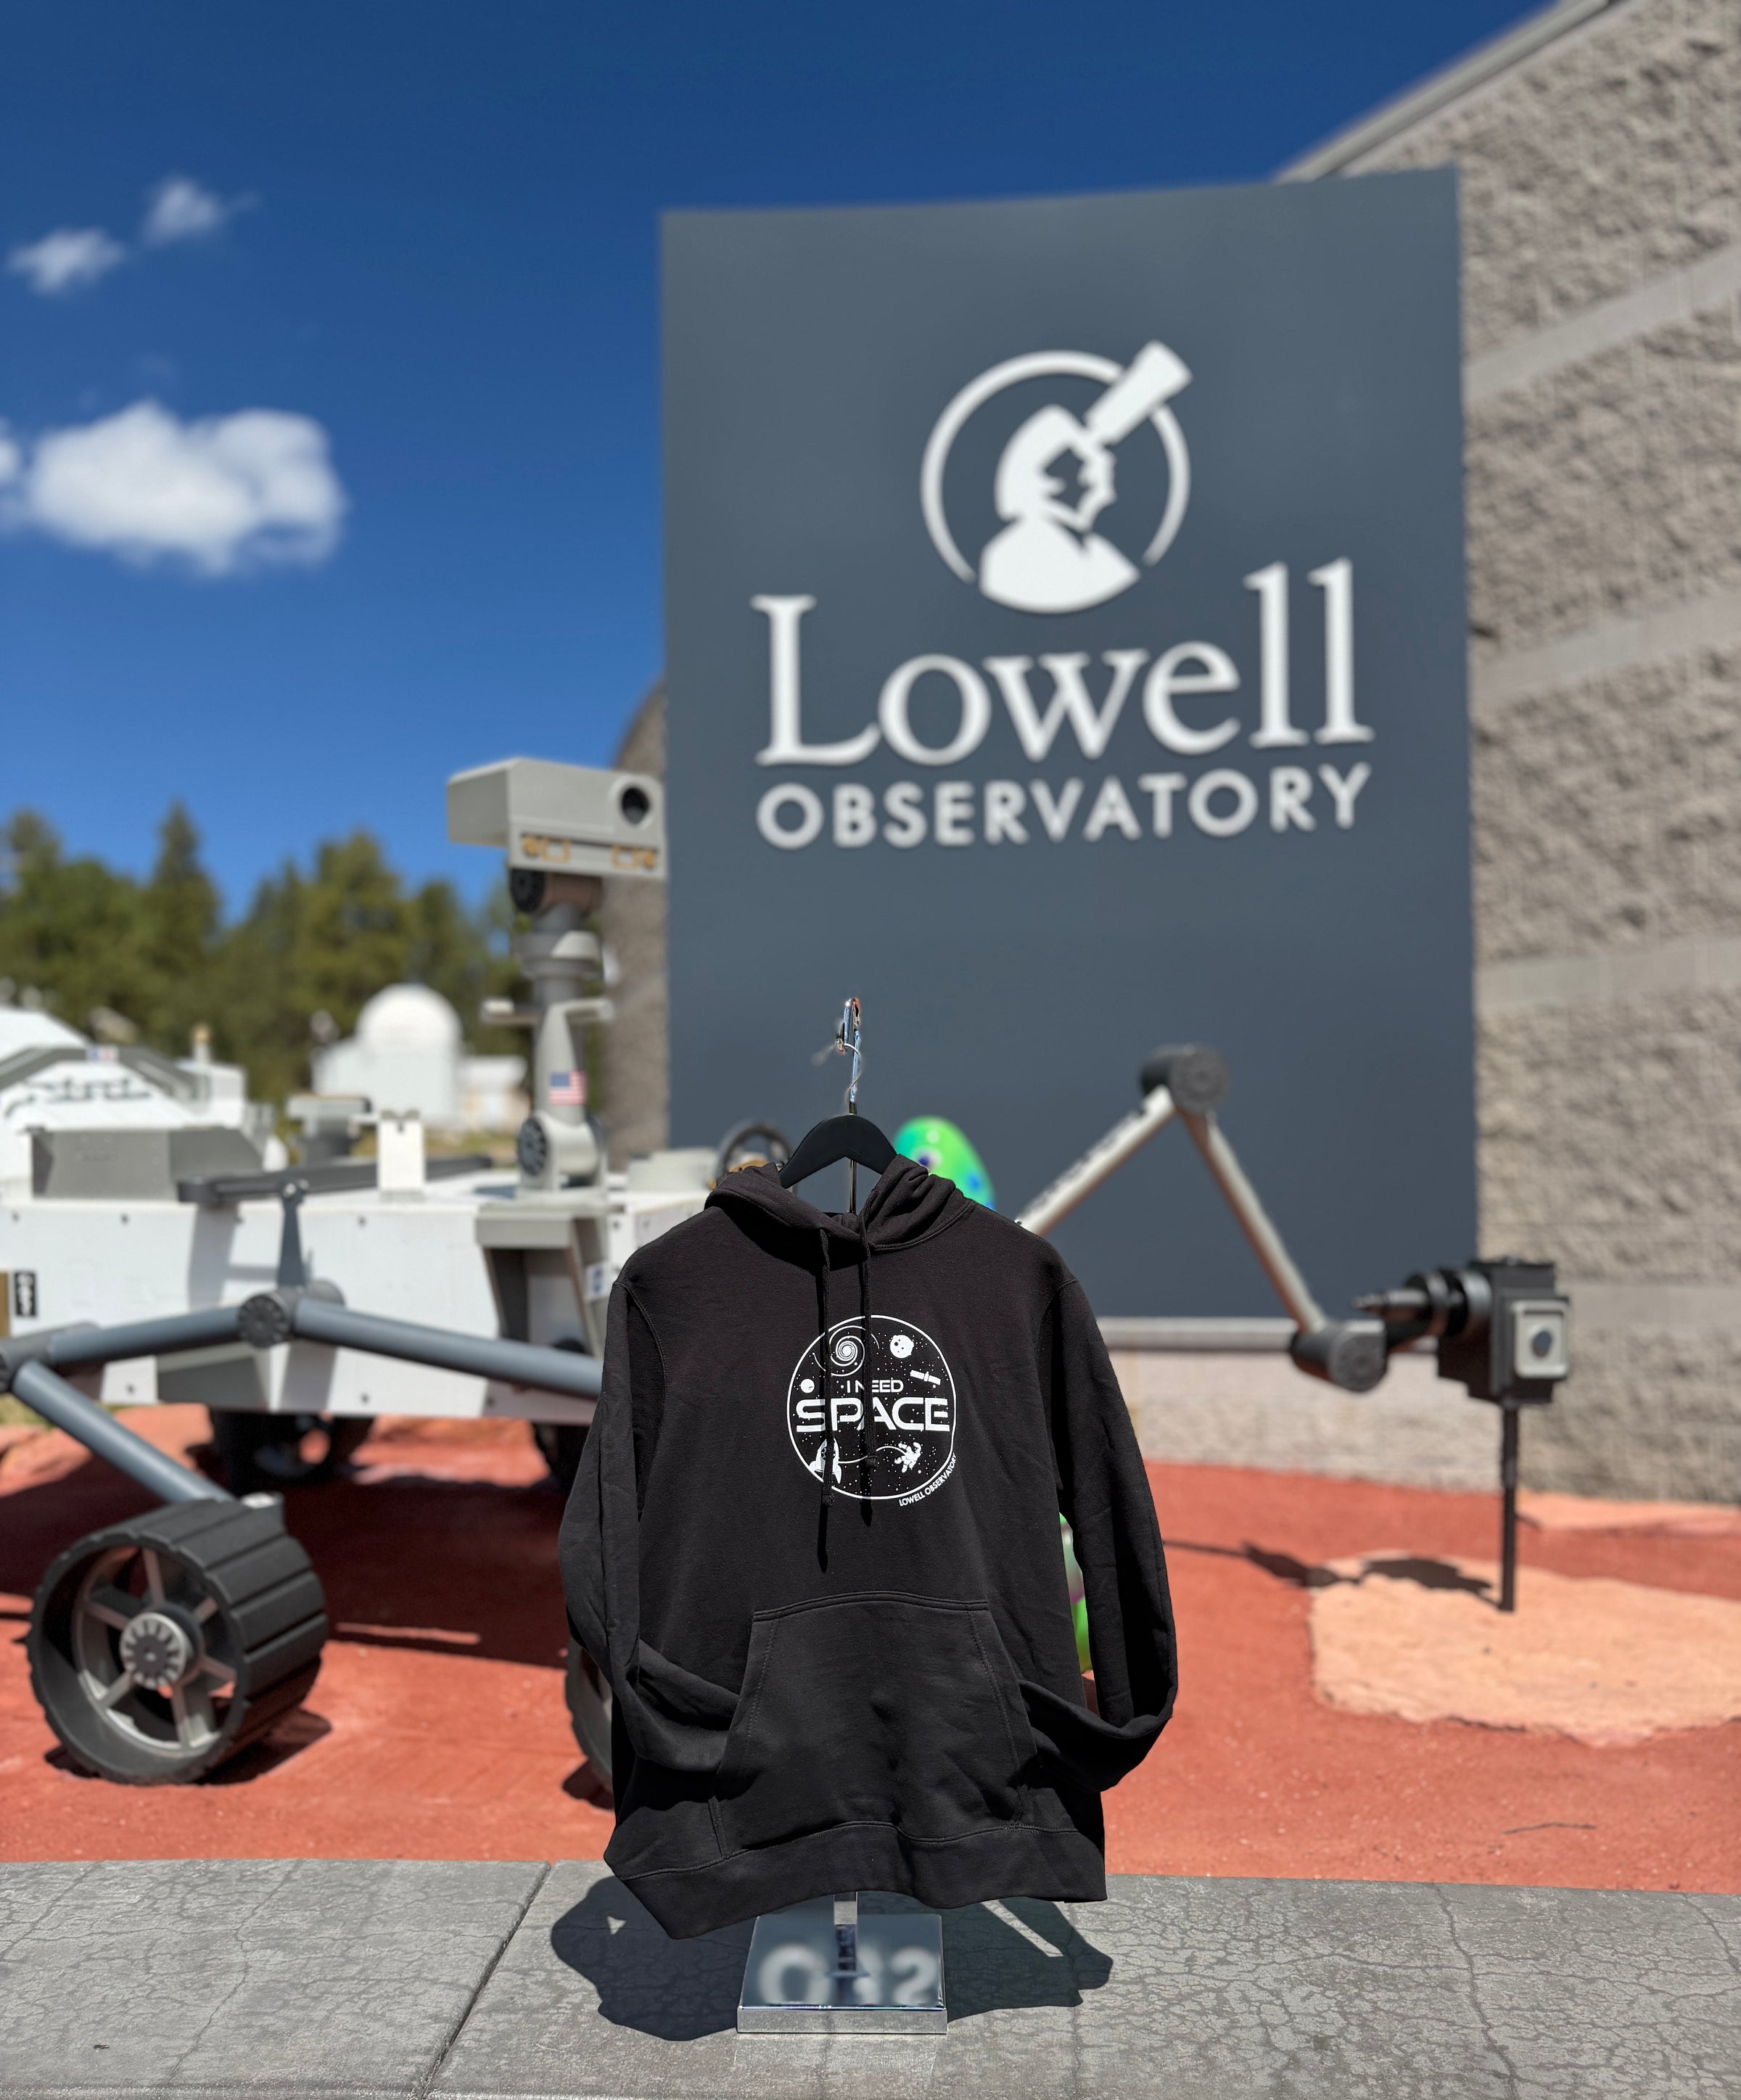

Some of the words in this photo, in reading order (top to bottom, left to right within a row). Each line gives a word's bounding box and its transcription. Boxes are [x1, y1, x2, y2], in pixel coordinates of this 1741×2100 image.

[750, 556, 1375, 766] Lowell
[756, 762, 1371, 849] OBSERVATORY
[847, 1380, 851, 1393] I
[796, 1397, 950, 1433] SPACE
[899, 1491, 926, 1507] LOWELL
[924, 1452, 957, 1495] OBSERVATORY
